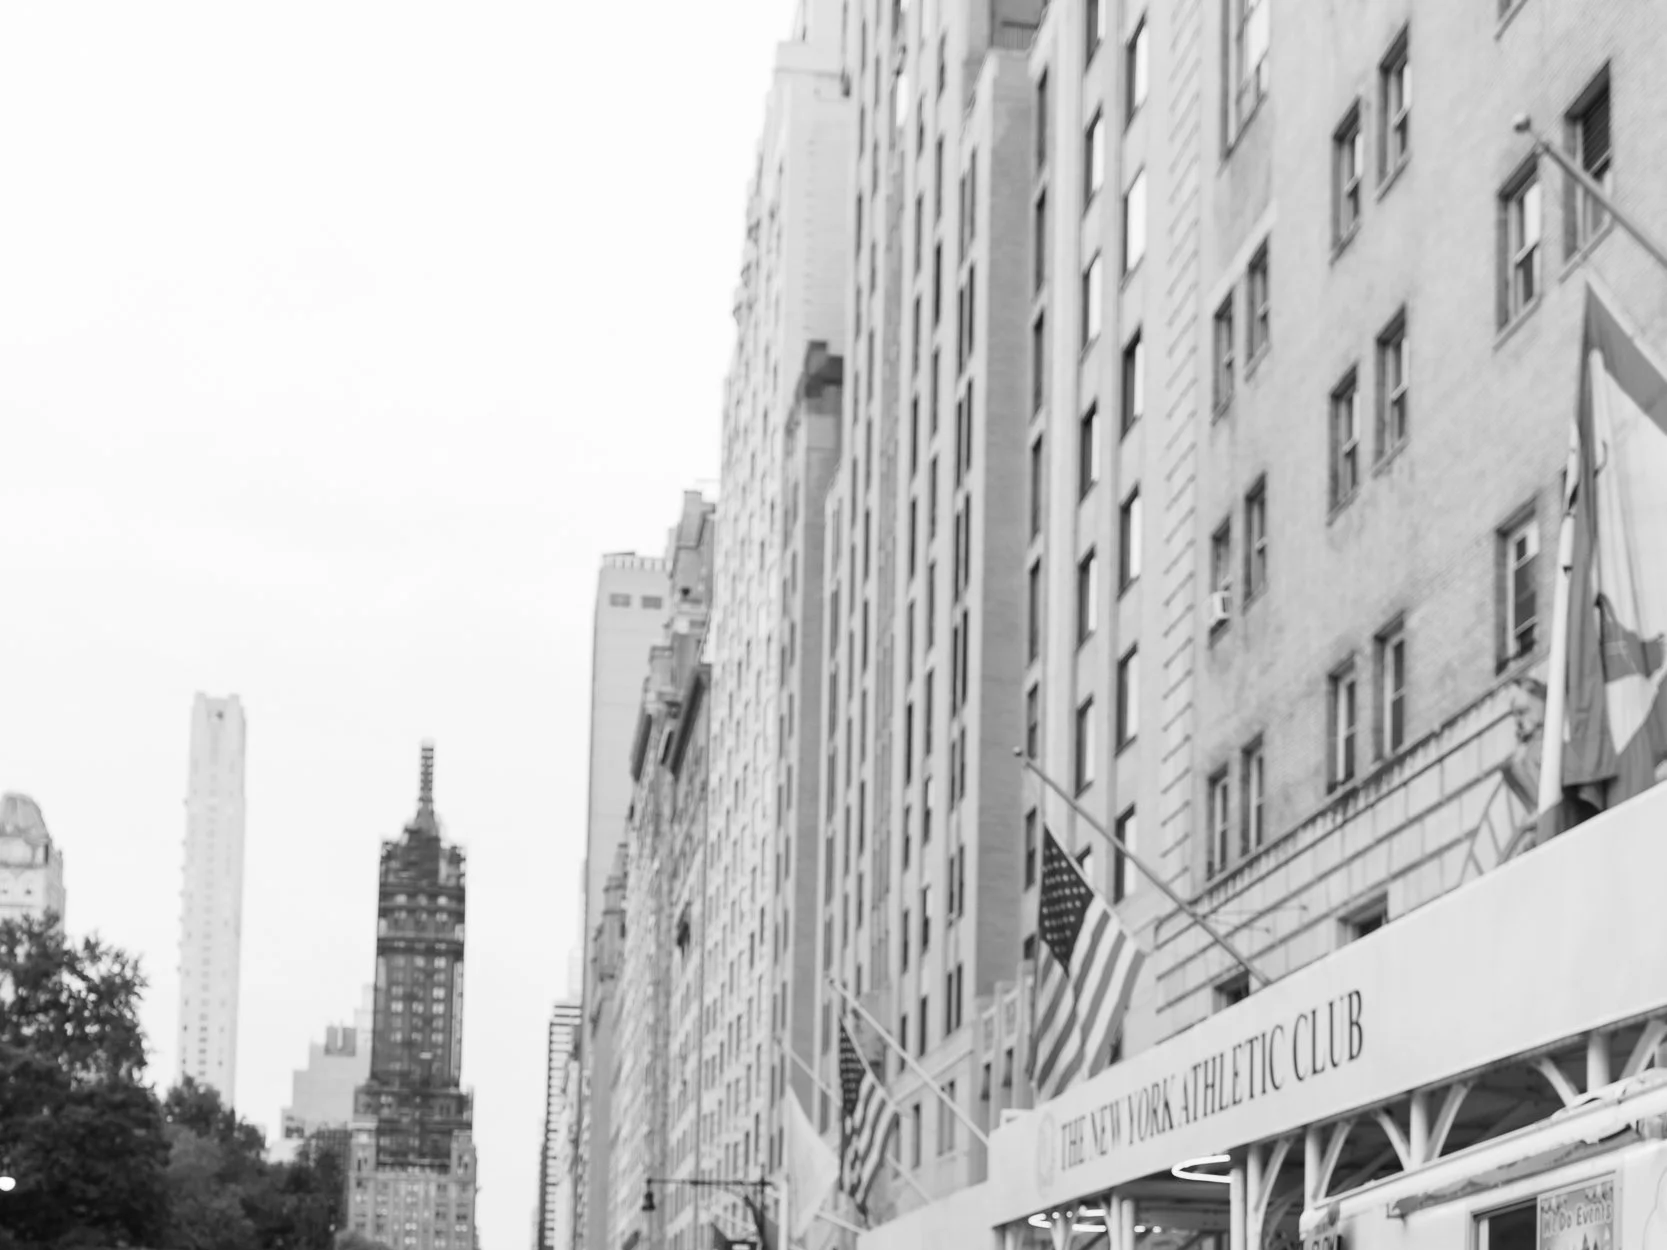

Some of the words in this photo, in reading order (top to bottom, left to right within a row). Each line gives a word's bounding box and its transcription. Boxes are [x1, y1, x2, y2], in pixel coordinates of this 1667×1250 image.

[1061, 1114, 1086, 1172] THE
[1090, 1099, 1122, 1159] NEW
[1127, 1075, 1177, 1146] YORK
[1178, 1024, 1285, 1129] ATHLETIC
[1293, 989, 1363, 1082] CLUB
[1575, 1200, 1613, 1227] Events
